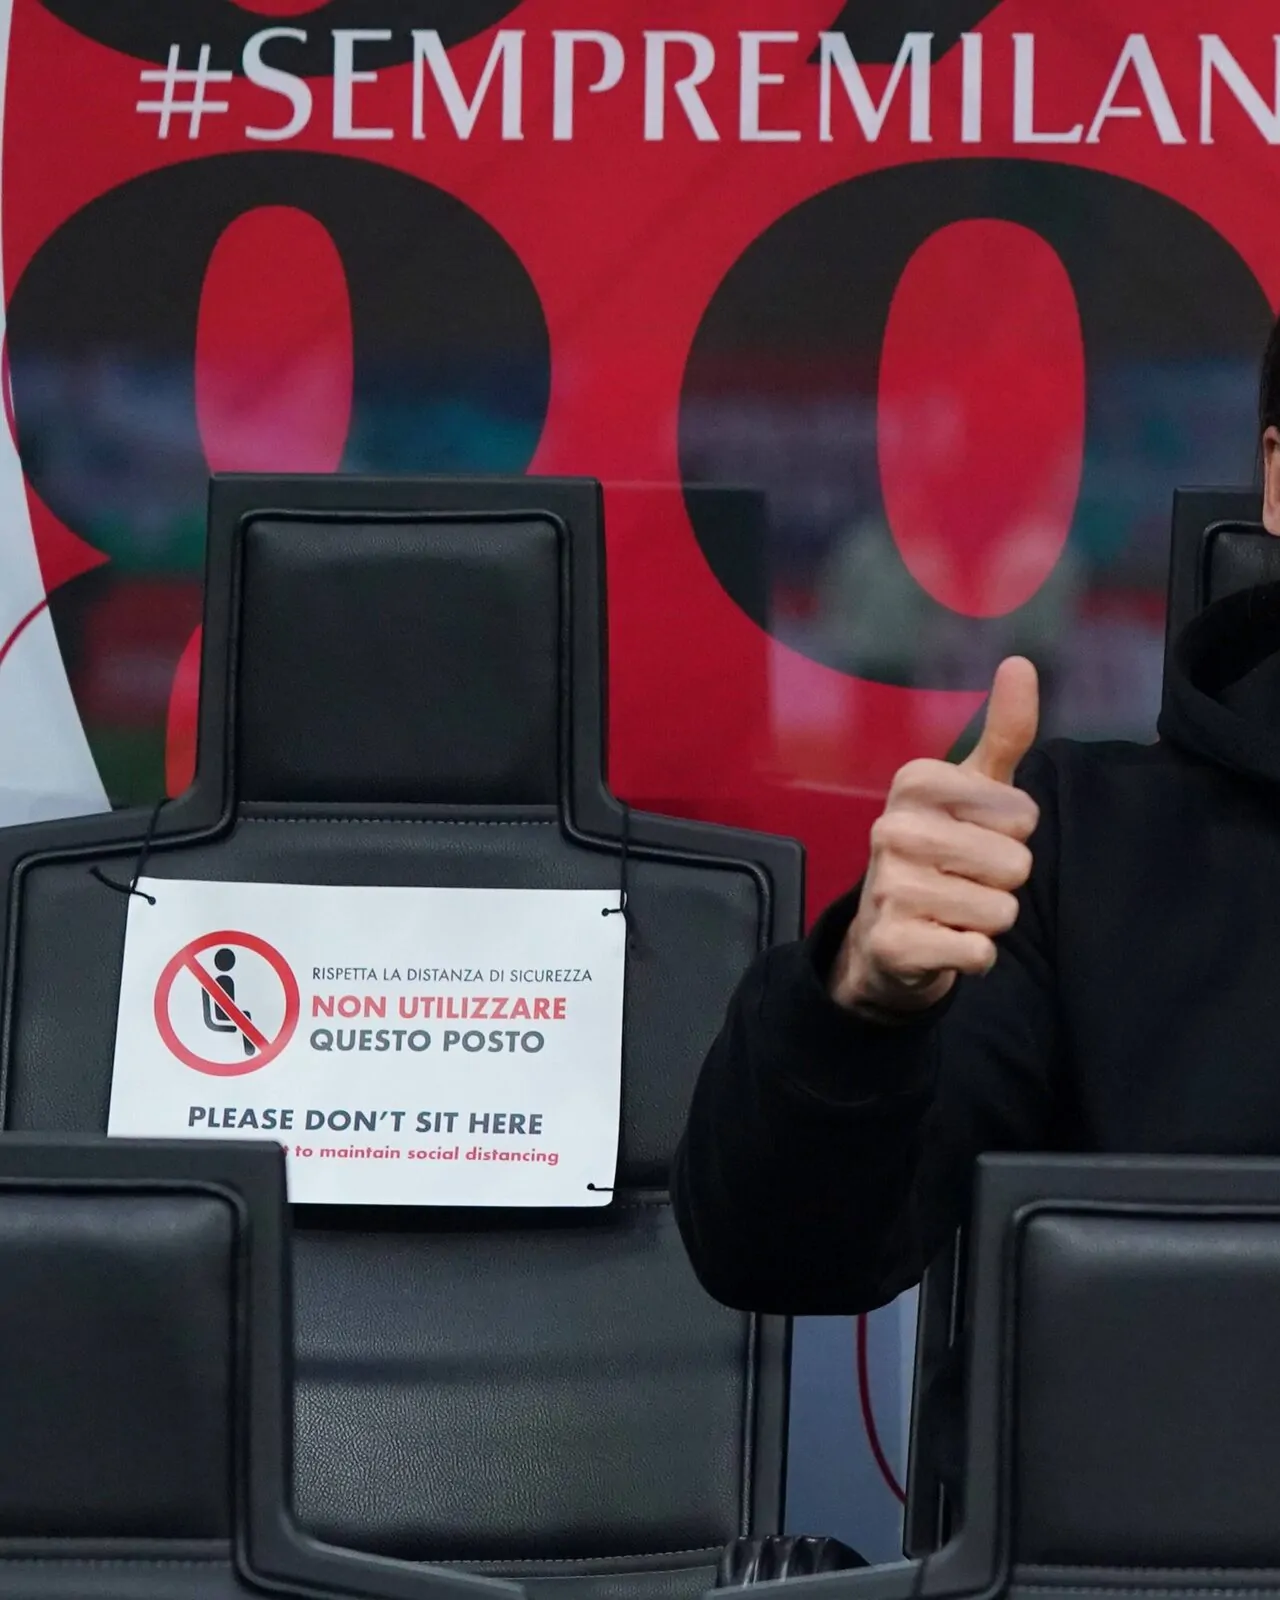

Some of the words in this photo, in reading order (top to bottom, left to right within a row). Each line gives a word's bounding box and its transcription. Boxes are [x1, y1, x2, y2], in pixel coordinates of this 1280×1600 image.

[312, 966, 378, 982] RISPETTA
[383, 967, 402, 982] LA
[407, 967, 484, 983] DISTANZA
[490, 969, 505, 983] DI
[509, 968, 593, 983] SICUREZZA
[311, 995, 387, 1019] NON
[398, 996, 567, 1020] UTILIZZARE
[309, 1028, 432, 1053] QUESTO
[442, 1030, 545, 1054] POSTO
[187, 1105, 295, 1131] PLEASE
[304, 1109, 407, 1133] DON'T
[415, 1111, 460, 1135] SIT
[468, 1113, 543, 1136] HERE
[295, 1145, 314, 1159] to
[319, 1145, 401, 1160] maintain
[407, 1146, 460, 1162] social
[465, 1146, 560, 1168] distancing
